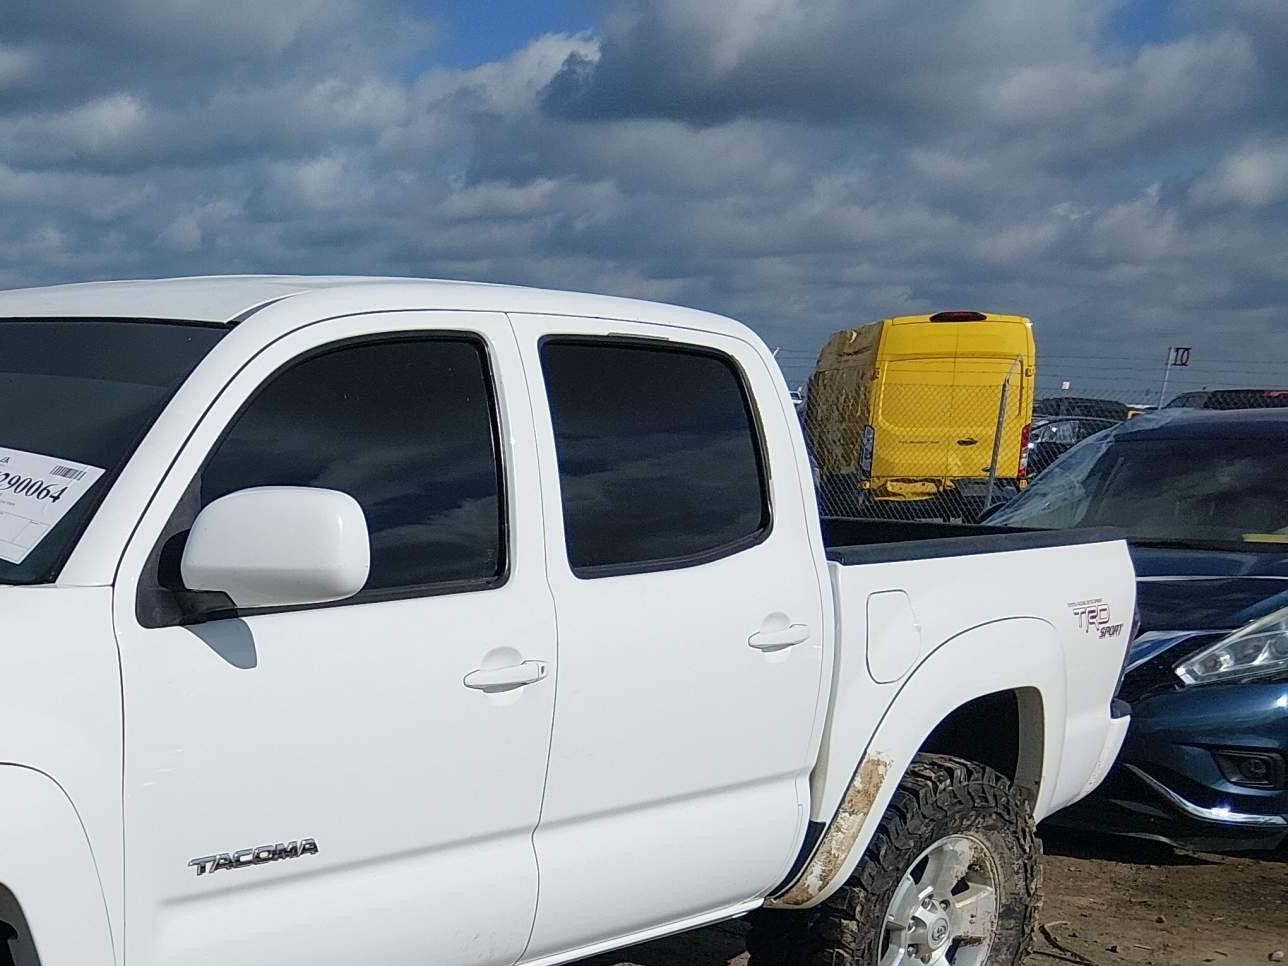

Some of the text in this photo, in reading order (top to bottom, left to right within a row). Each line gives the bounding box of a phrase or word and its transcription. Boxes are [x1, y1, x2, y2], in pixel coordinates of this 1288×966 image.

[1073, 604, 1110, 633] TRD
[1099, 624, 1123, 639] SPORT
[187, 837, 320, 876] TACOMA
